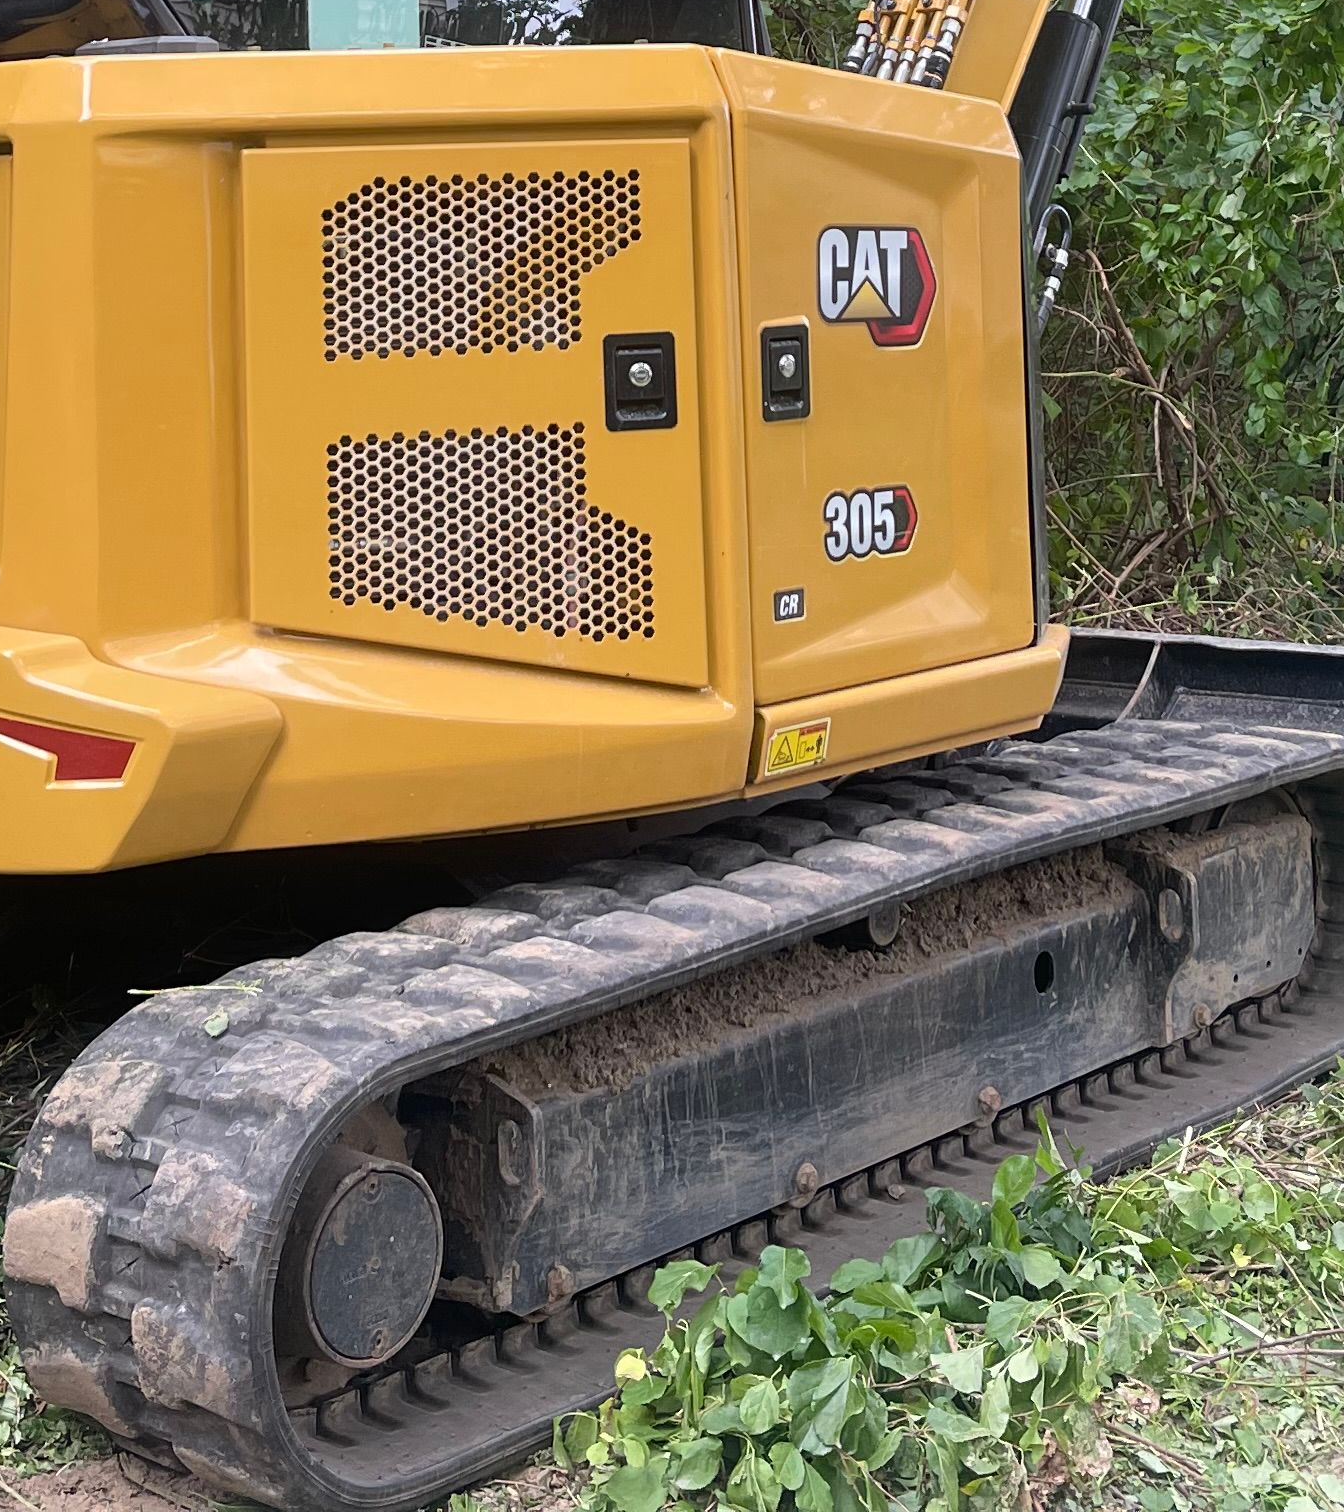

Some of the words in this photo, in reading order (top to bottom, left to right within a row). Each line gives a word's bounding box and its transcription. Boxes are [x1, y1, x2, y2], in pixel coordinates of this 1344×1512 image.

[819, 228, 908, 320] CAT
[825, 490, 895, 558] 305
[779, 593, 799, 617] CR
